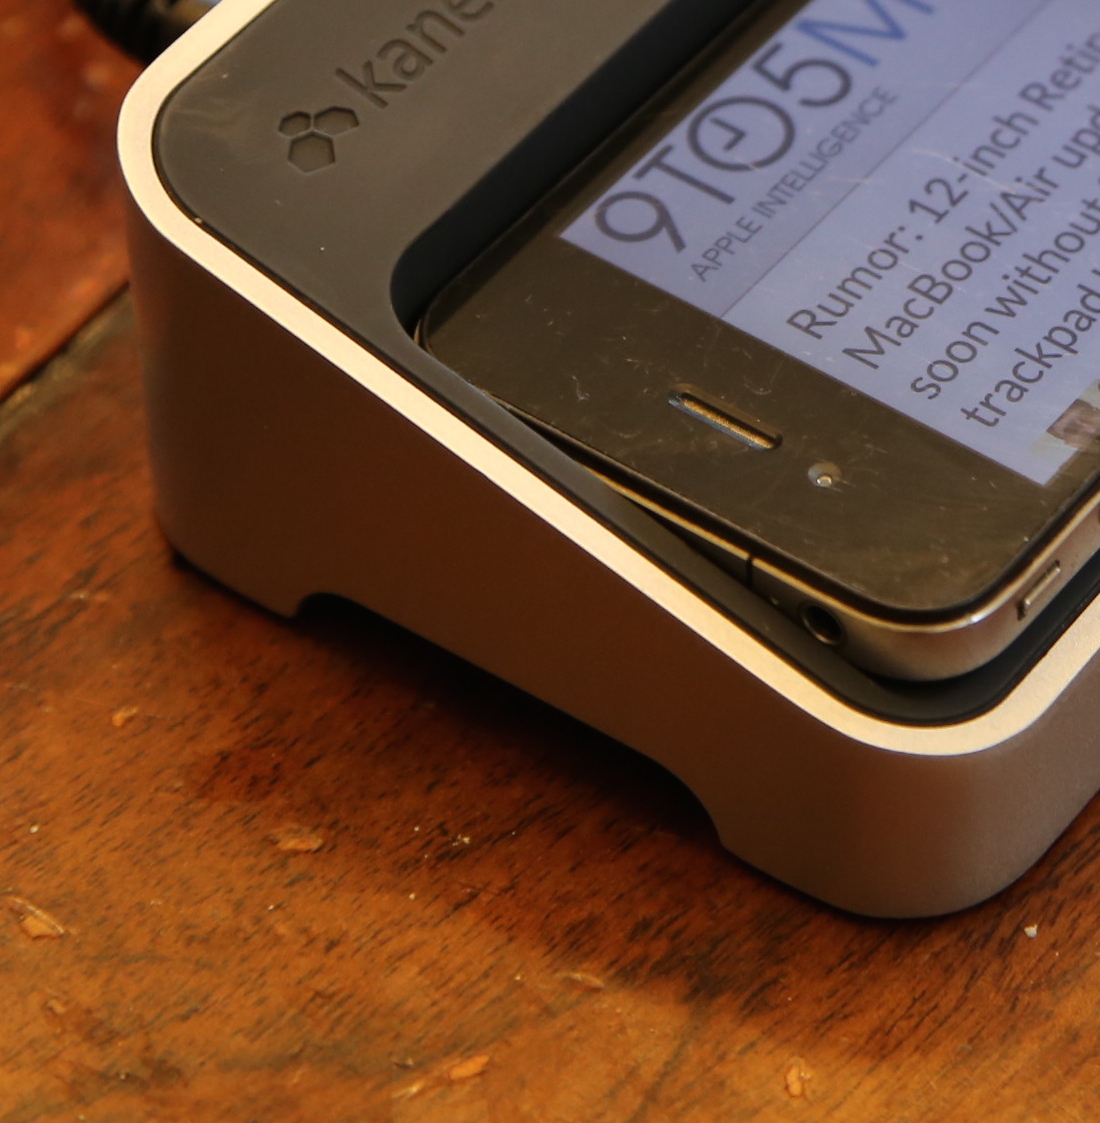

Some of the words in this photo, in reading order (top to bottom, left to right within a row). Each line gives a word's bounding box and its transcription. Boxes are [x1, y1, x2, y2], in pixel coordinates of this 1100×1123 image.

[691, 217, 763, 282] APPLE
[752, 87, 897, 218] INTELLIGENCE
[786, 224, 923, 340] Rumor:
[908, 108, 1038, 224] 12-inch
[842, 166, 1060, 370] MacBook/Air
[910, 319, 1001, 400] soon
